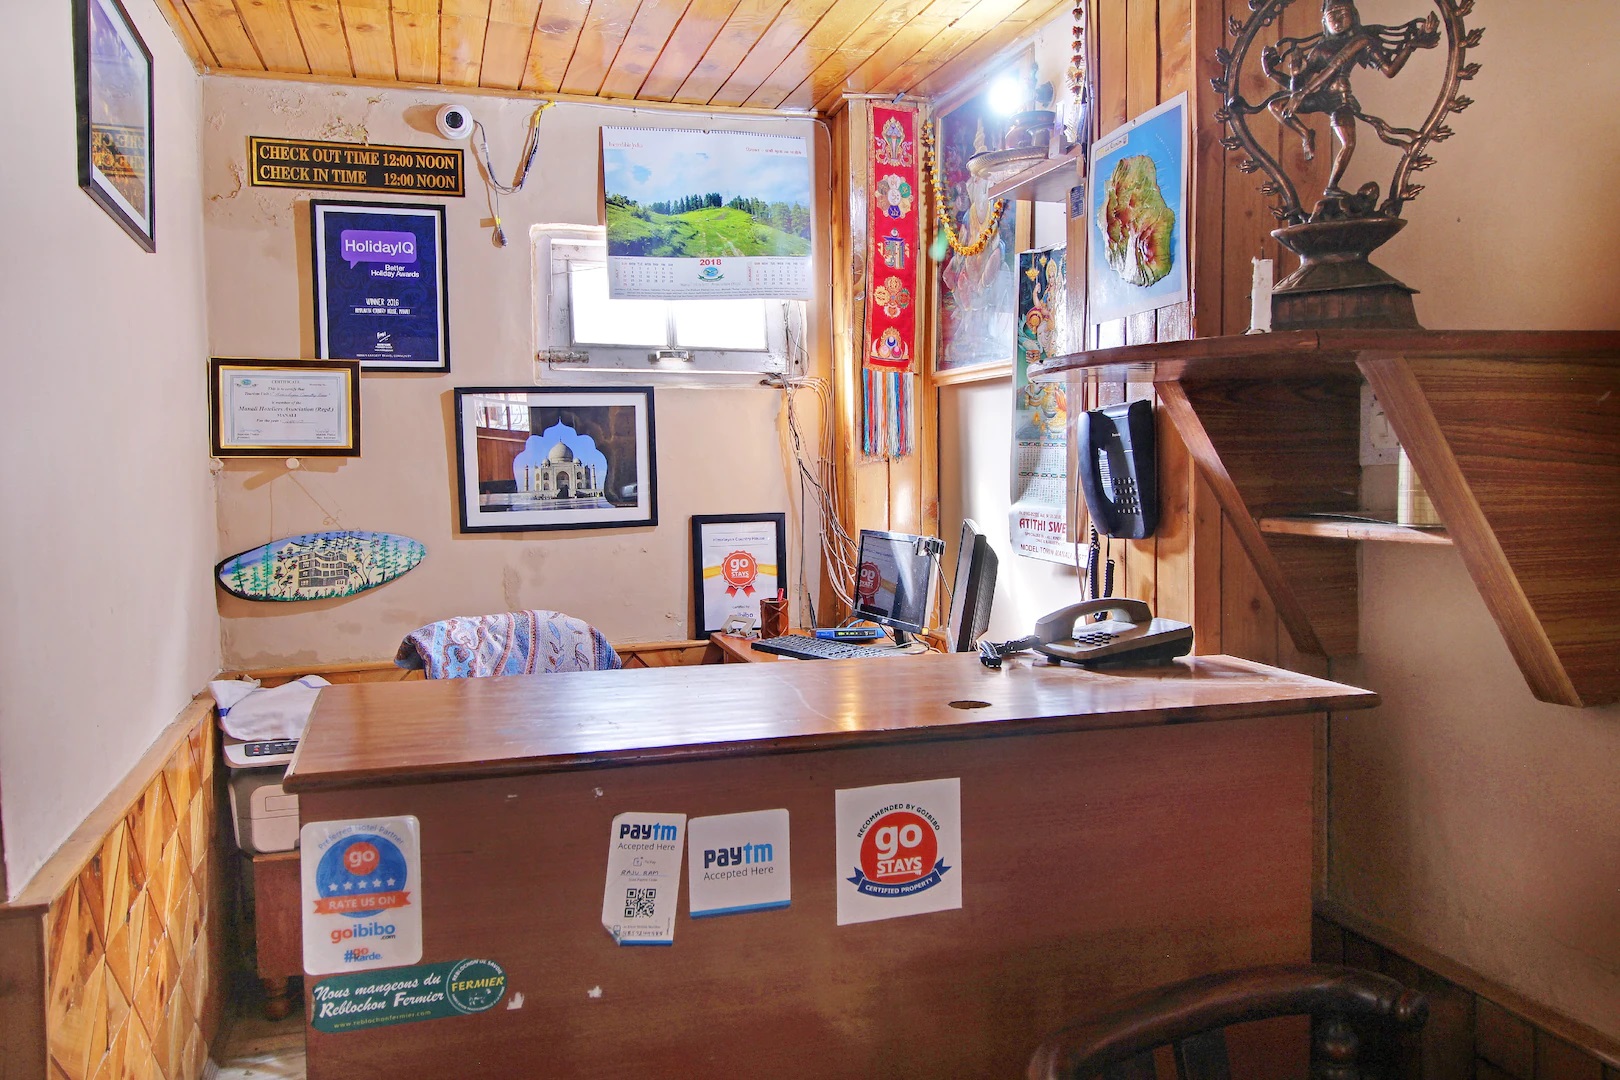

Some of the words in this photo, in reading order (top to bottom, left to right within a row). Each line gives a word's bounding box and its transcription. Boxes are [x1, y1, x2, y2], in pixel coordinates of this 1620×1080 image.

[259, 144, 310, 162] CHECK
[312, 148, 342, 164] OUT
[344, 151, 380, 166] TIME
[382, 153, 414, 168] 12:00
[416, 154, 455, 170] NOON
[260, 164, 310, 180] CHECK
[312, 168, 328, 182] IN
[332, 169, 366, 184] TIME
[384, 172, 414, 187] 12:00
[416, 173, 456, 188] NOON
[345, 240, 414, 256] HolidayIQ
[371, 270, 395, 278] Holiday
[366, 298, 385, 306] WINNER
[1020, 518, 1045, 531] ATITHI
[1020, 544, 1038, 552] MODEL
[730, 558, 749, 572] go
[857, 804, 904, 838] RECOMMENDED
[916, 807, 940, 831] GOIBIBO
[378, 826, 404, 844] Partner
[875, 824, 923, 860] go
[617, 842, 654, 851] Accepted
[349, 850, 375, 868] go
[877, 856, 923, 874] STAYS
[703, 868, 748, 881] Accepted
[751, 865, 774, 876] Here
[865, 884, 900, 894] CERTIFIED
[901, 876, 933, 893] PROPERTY
[329, 900, 357, 910] RATE
[361, 898, 375, 907] US
[378, 896, 396, 905] ON
[331, 922, 396, 944] goibibo
[314, 986, 350, 1001] Nous
[355, 979, 420, 997] mangeons
[424, 972, 442, 985] du
[452, 976, 505, 992] FERMIER
[319, 997, 386, 1018] Reblochon
[393, 991, 445, 1008] Fermier
[334, 1010, 432, 1029] www.reblochonfermier.com
